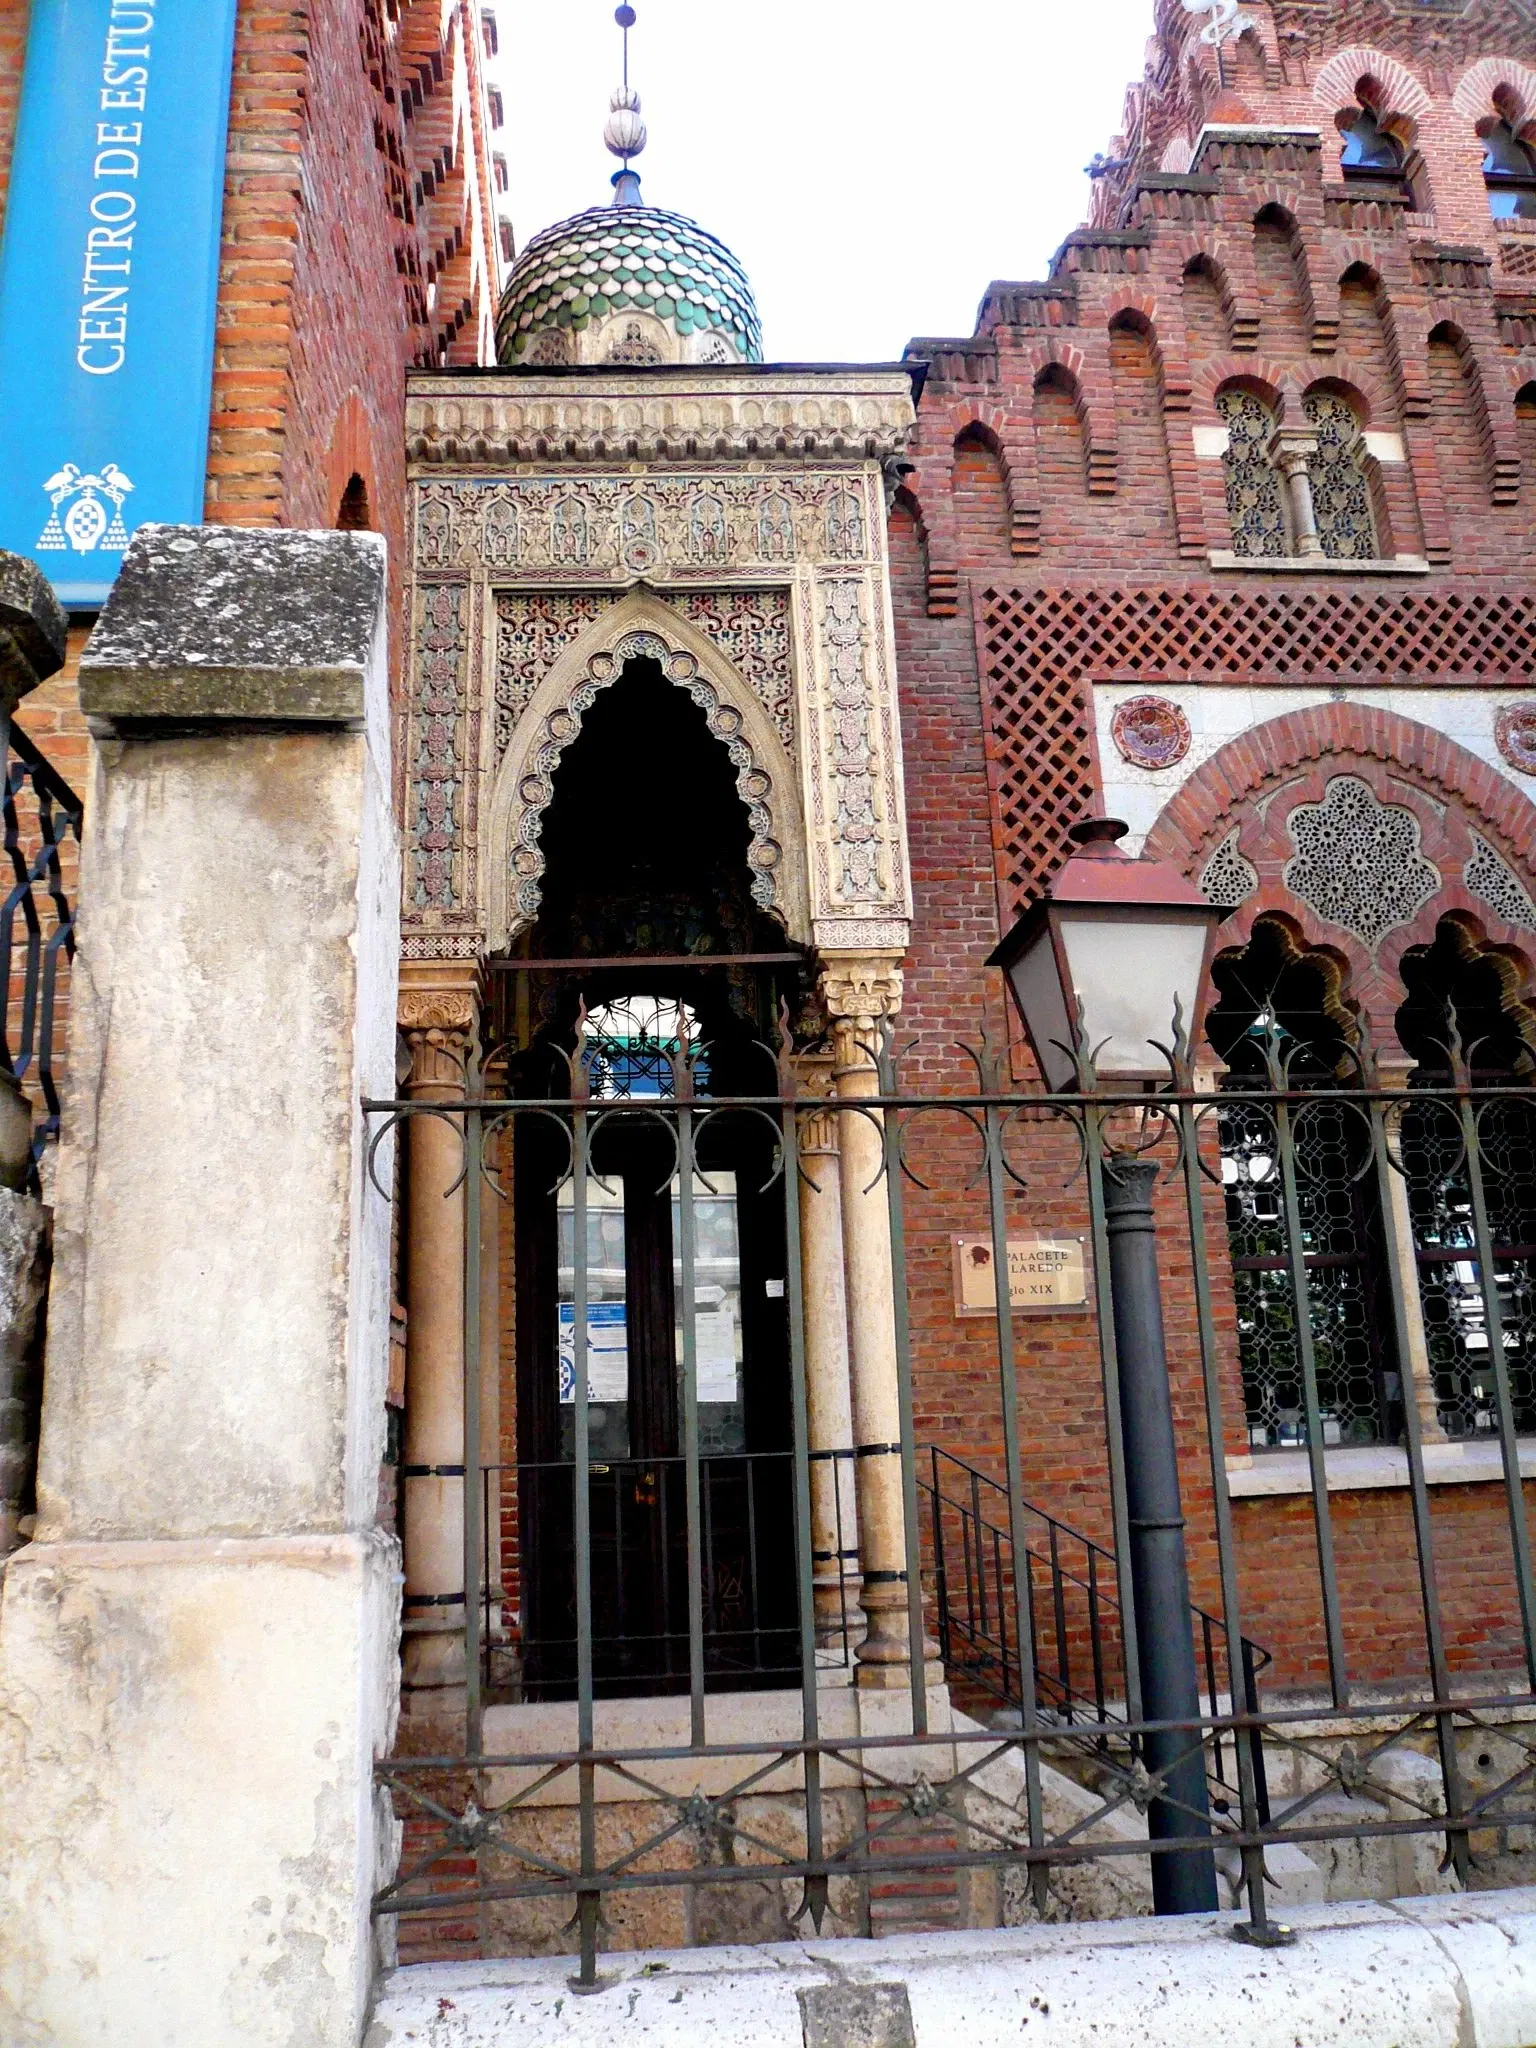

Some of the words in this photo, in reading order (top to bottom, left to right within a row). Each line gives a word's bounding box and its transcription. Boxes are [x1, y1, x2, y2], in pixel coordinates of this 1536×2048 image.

[100, 0, 155, 111] ESTU
[94, 122, 142, 179] DE
[77, 191, 136, 375] CENTRO
[1011, 1262, 1064, 1274] LAREDO
[1030, 1284, 1053, 1295] XIX
